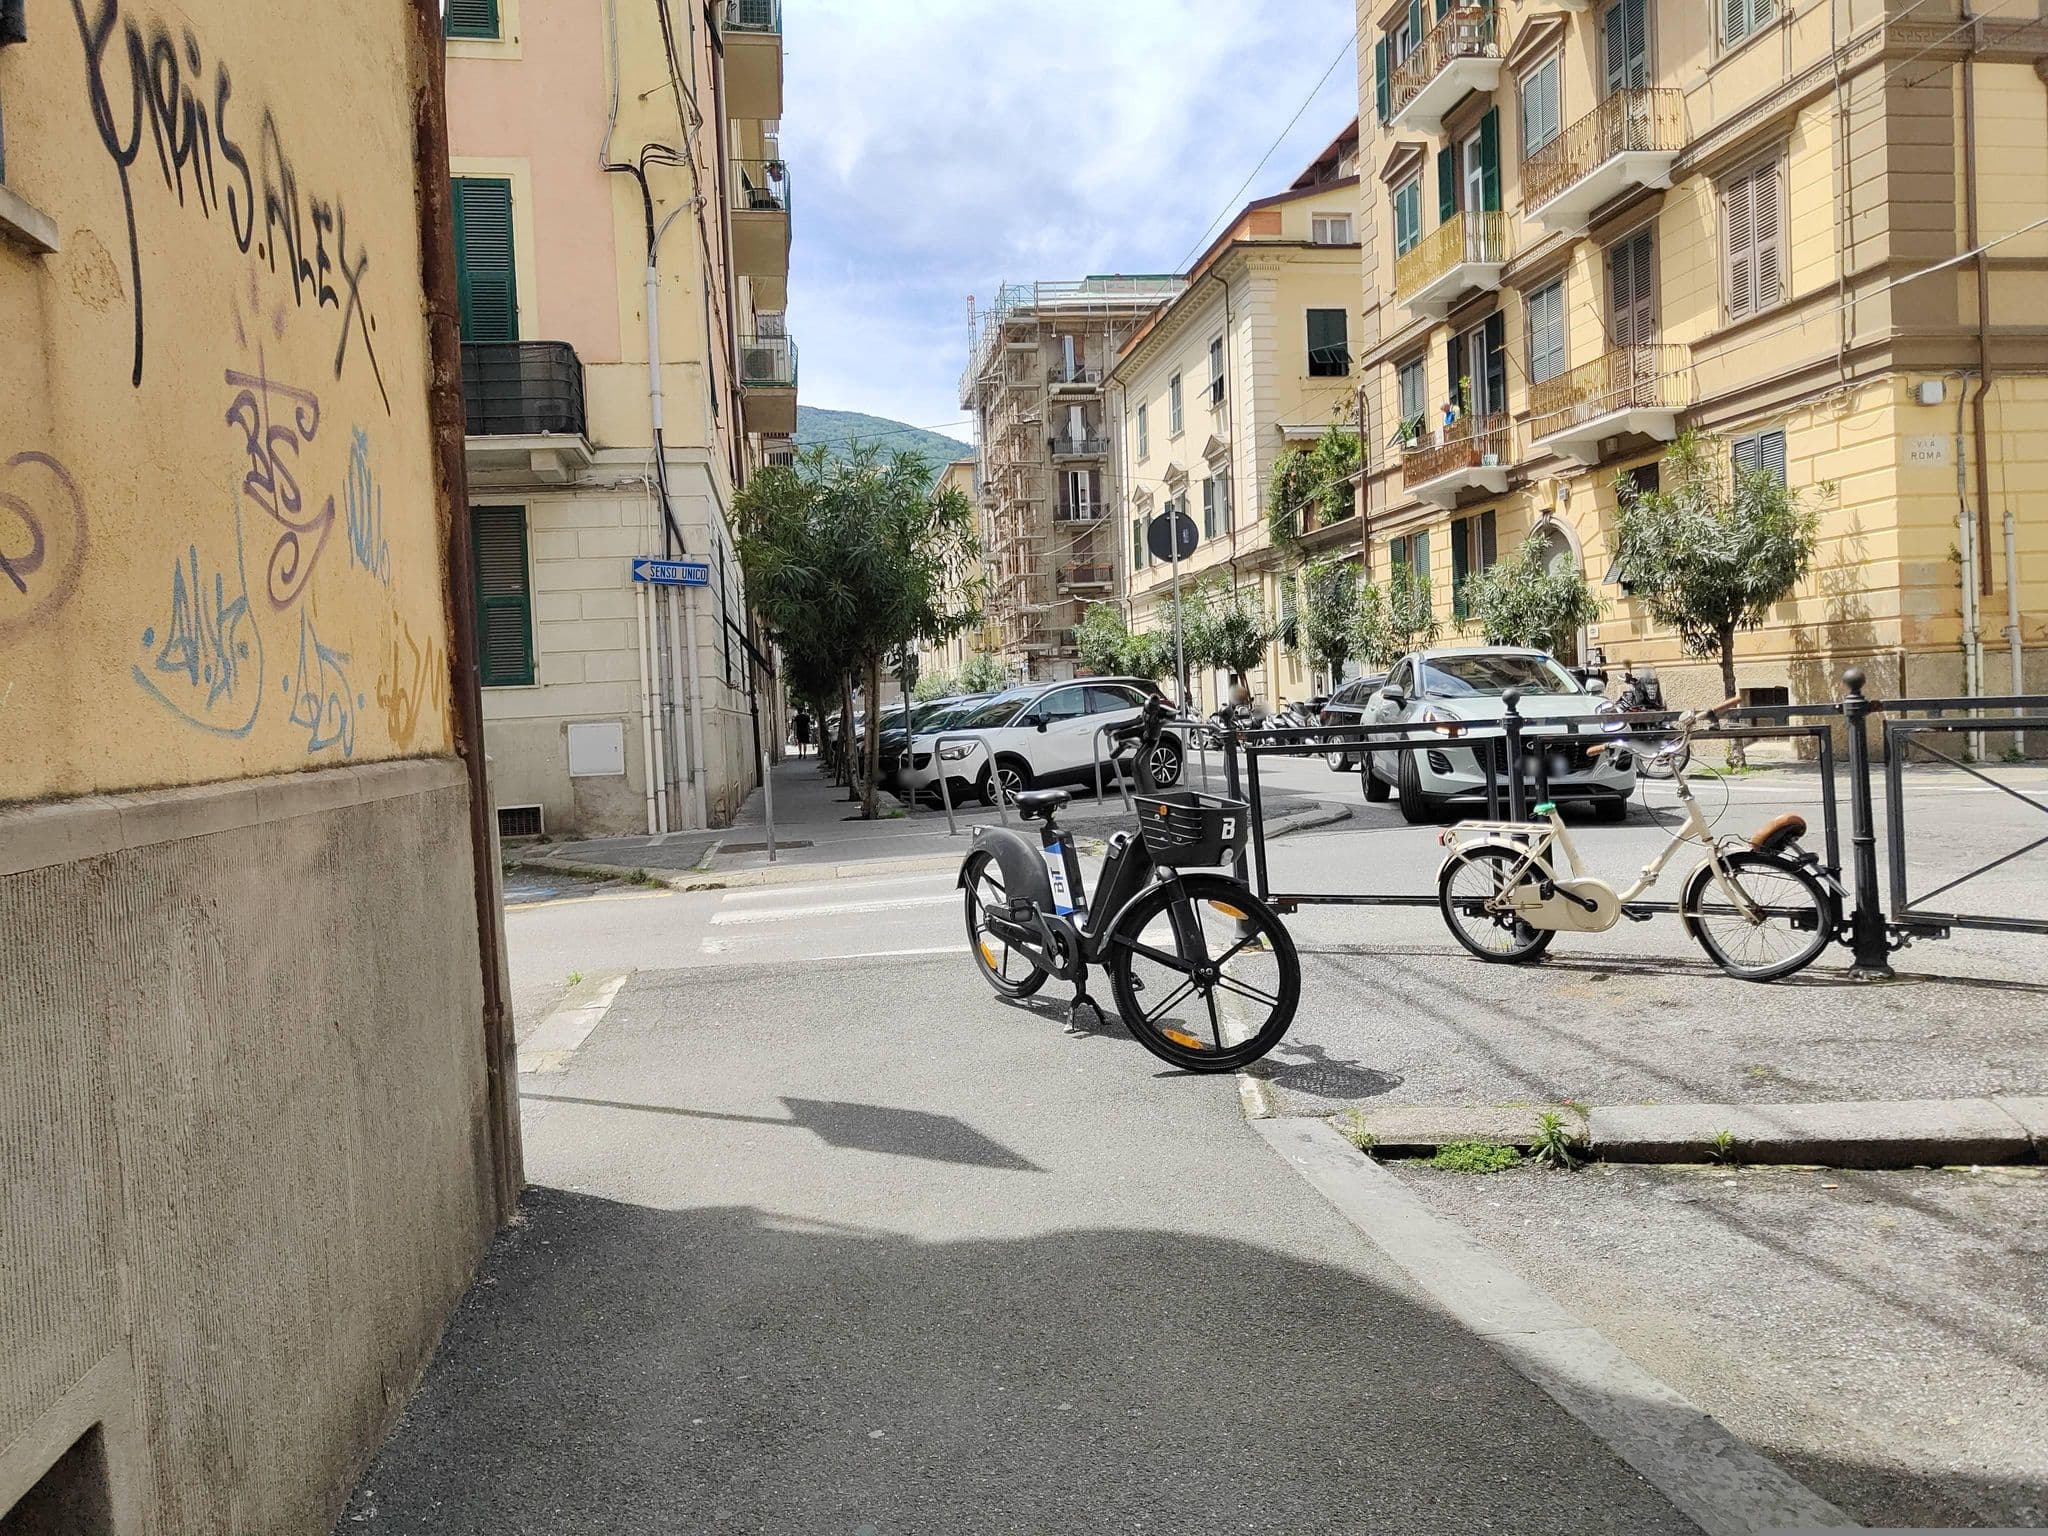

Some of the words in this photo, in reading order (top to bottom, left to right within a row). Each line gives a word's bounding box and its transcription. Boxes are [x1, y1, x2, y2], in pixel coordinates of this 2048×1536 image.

[1917, 440, 1936, 448] VIA
[1911, 451, 1942, 460] ROMA
[650, 565, 677, 579] SENSO
[682, 567, 706, 581] UNICO
[1221, 817, 1236, 840] B
